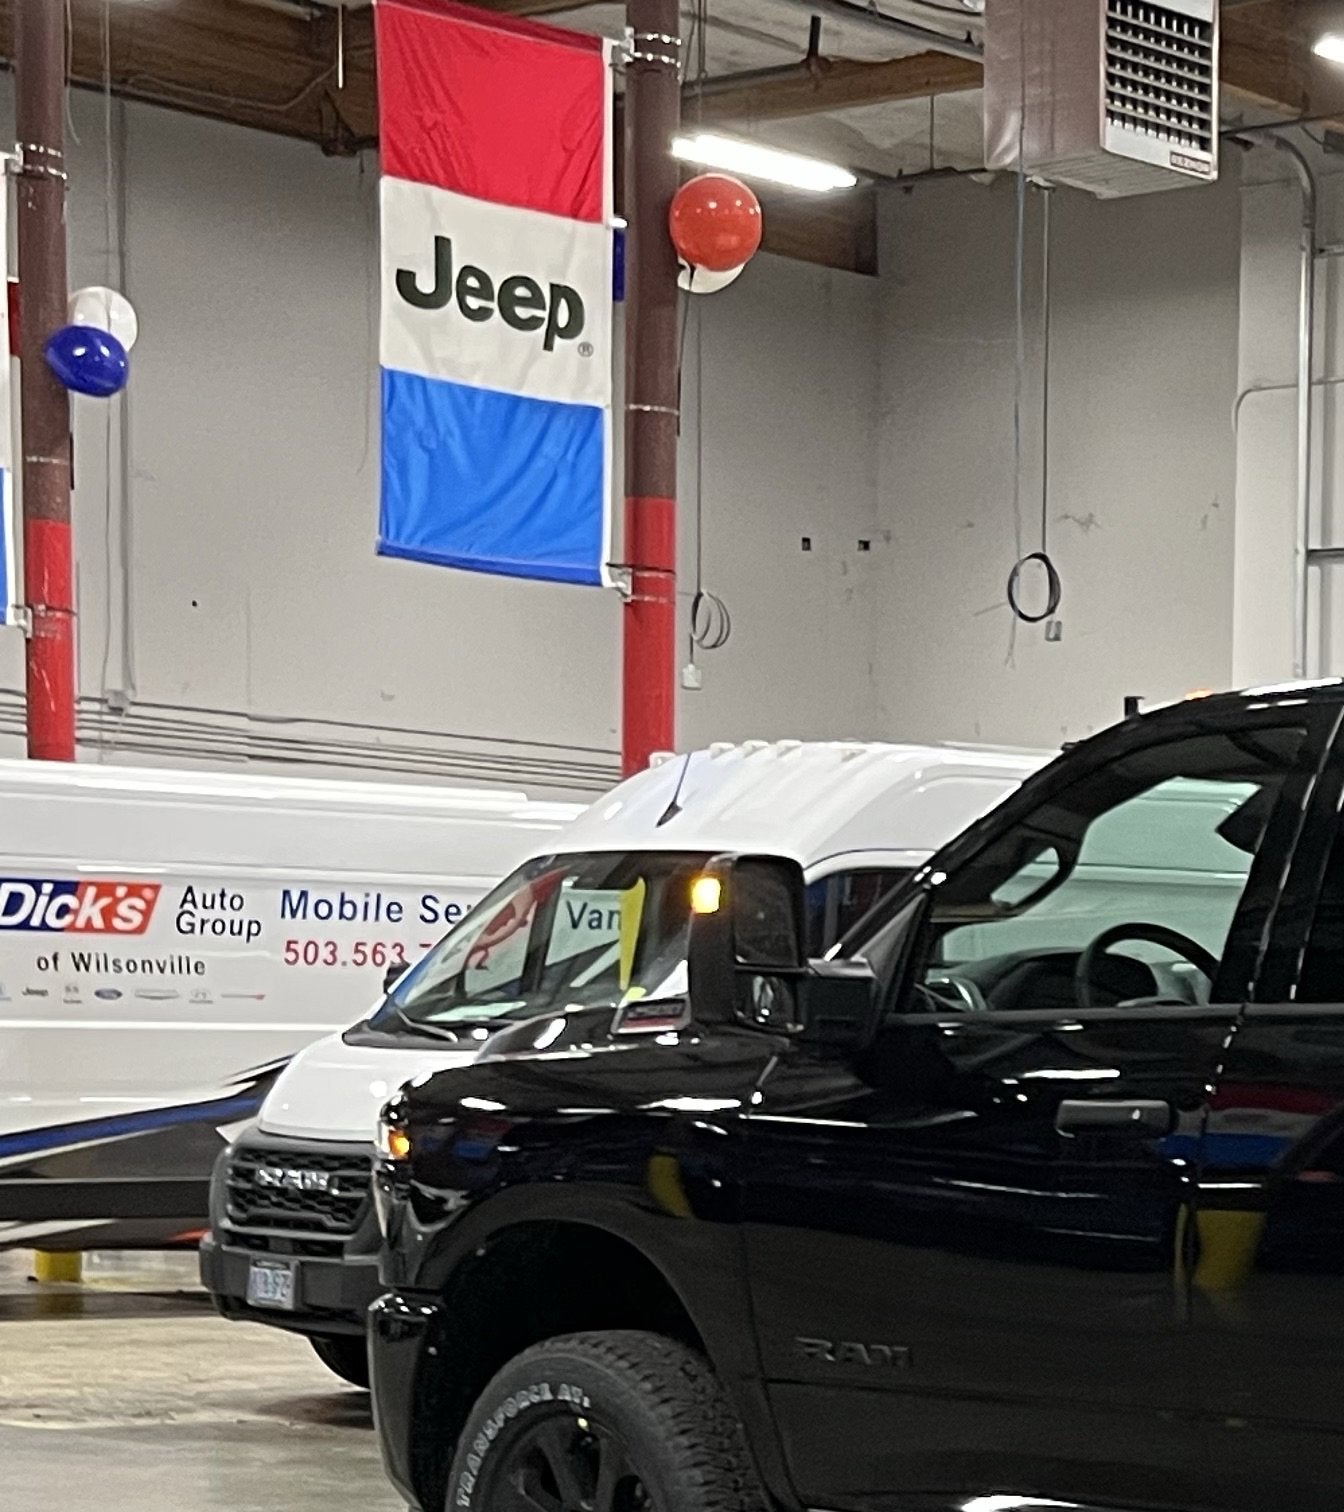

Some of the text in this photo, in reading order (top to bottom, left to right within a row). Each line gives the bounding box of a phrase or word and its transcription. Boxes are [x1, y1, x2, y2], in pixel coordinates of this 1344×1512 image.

[396, 235, 585, 352] Jeep
[0, 881, 147, 931] Dick's
[179, 885, 245, 912] Auto
[280, 889, 623, 931] Mobile Se Van
[176, 910, 262, 944] Group
[37, 952, 206, 975] of Wilsonville
